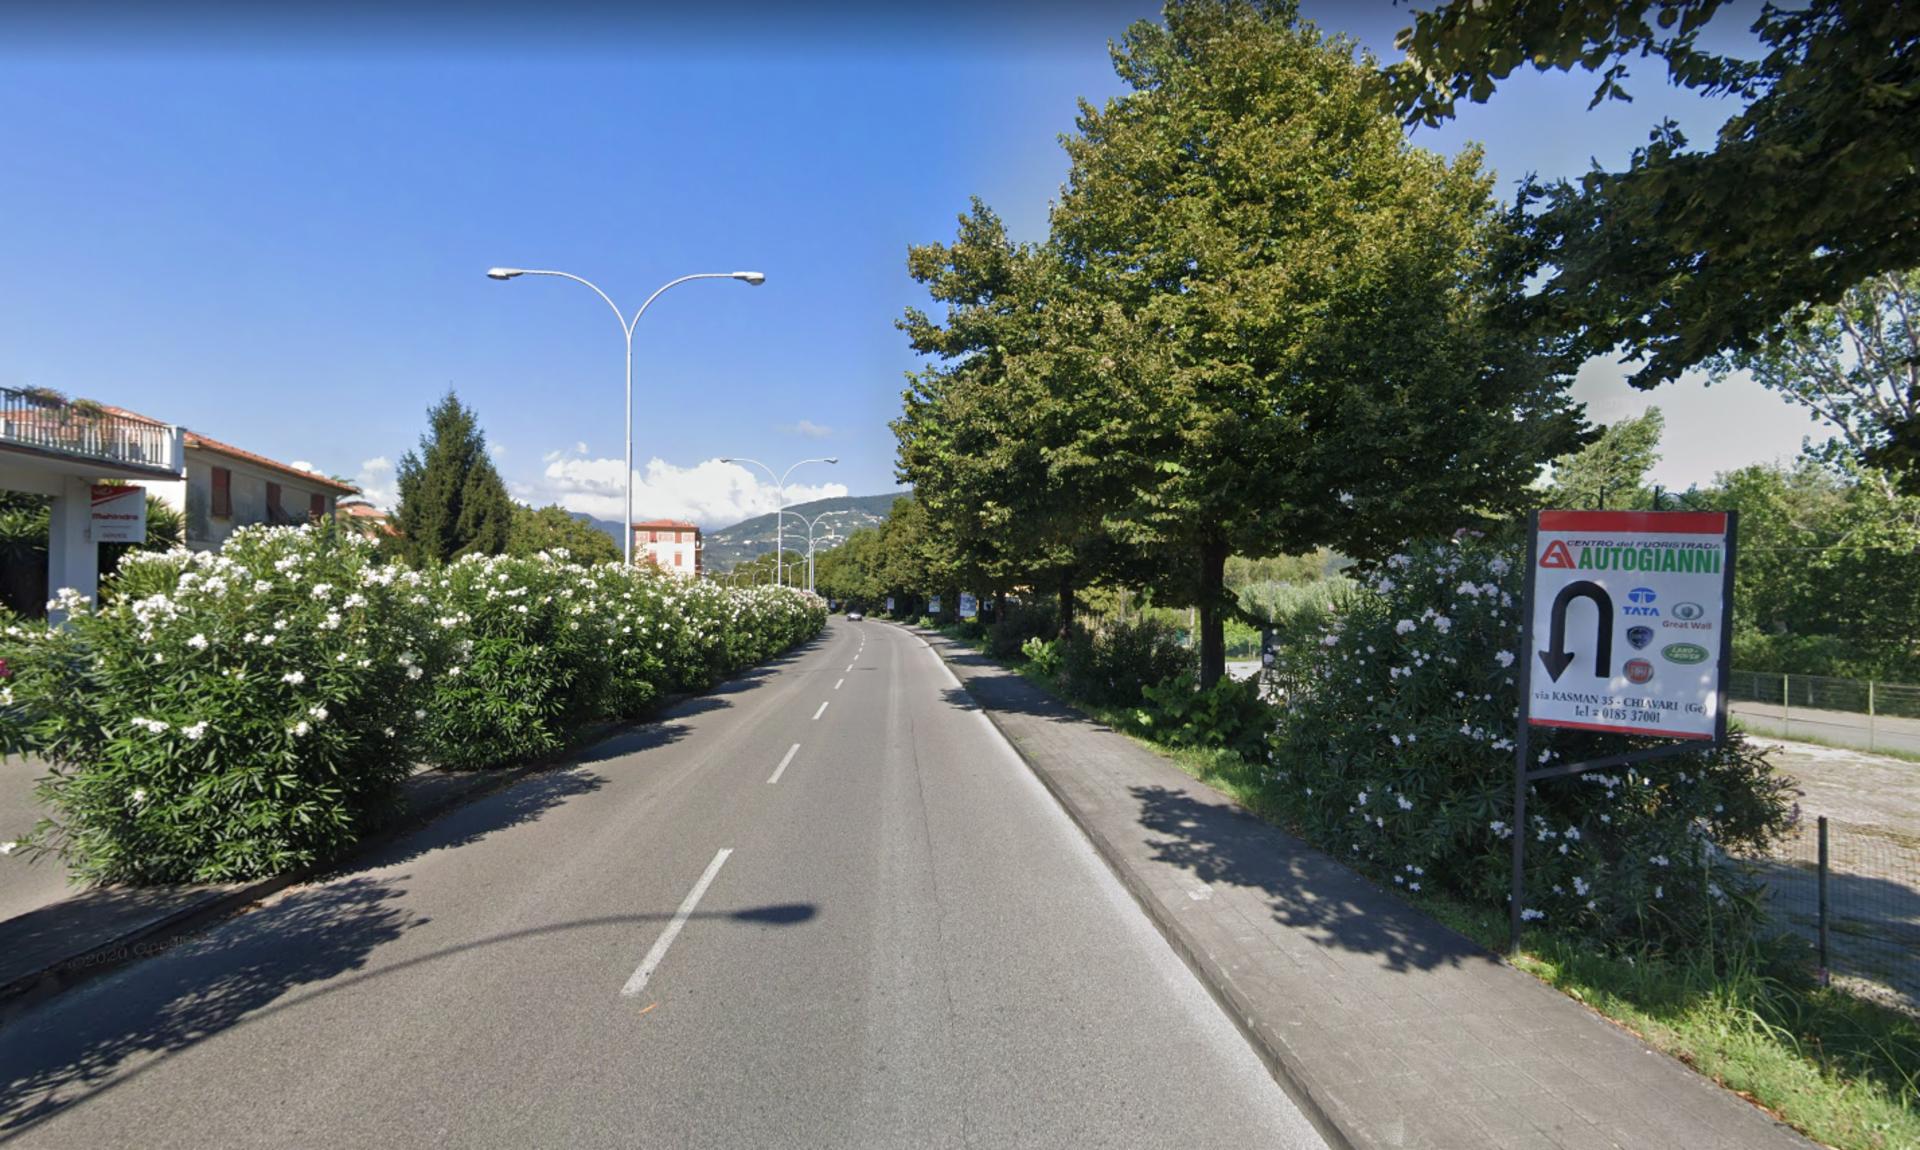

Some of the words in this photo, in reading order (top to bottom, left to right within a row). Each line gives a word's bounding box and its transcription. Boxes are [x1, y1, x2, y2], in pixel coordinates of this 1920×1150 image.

[1567, 540, 1614, 548] CENTRO
[1636, 541, 1720, 549] FUORISTRADA
[1578, 547, 1720, 573] AUTOGIANNI
[1623, 606, 1660, 617] TATA
[1662, 620, 1689, 629] Great
[1552, 692, 1599, 704] KASMAN
[1602, 696, 1614, 706] 35
[1602, 709, 1627, 721] 0185
